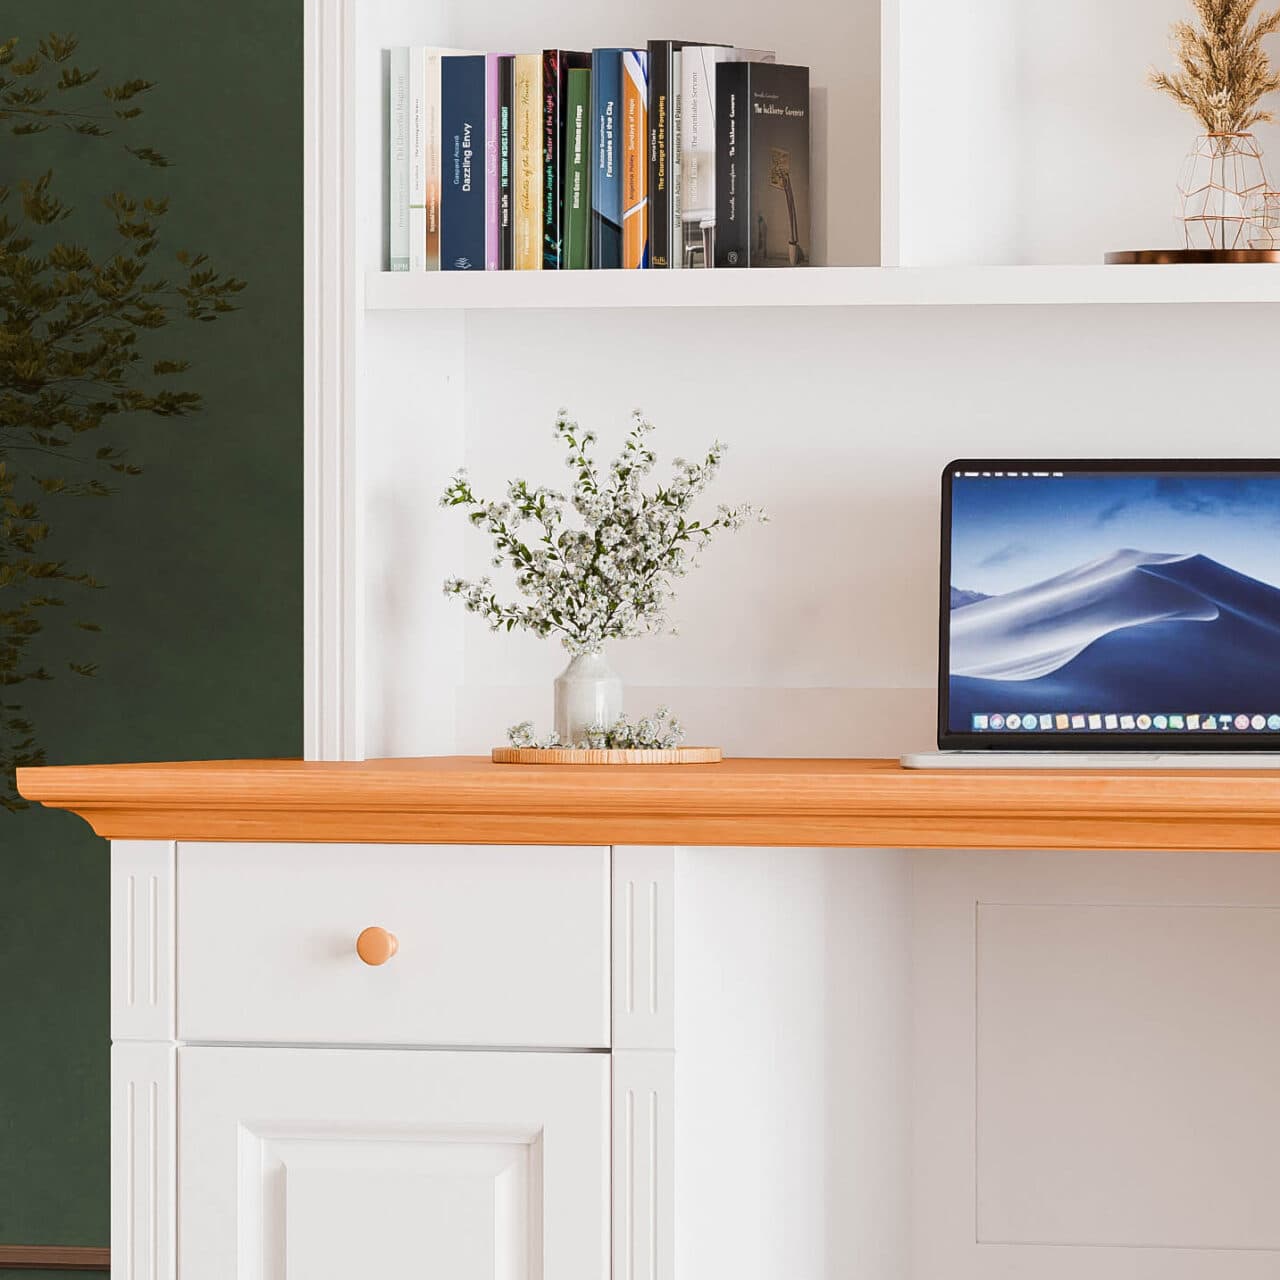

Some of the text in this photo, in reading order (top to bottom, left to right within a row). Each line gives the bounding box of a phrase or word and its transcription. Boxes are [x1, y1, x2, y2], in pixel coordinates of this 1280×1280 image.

[606, 131, 612, 139] of
[462, 123, 472, 191] Dazzling Envy
